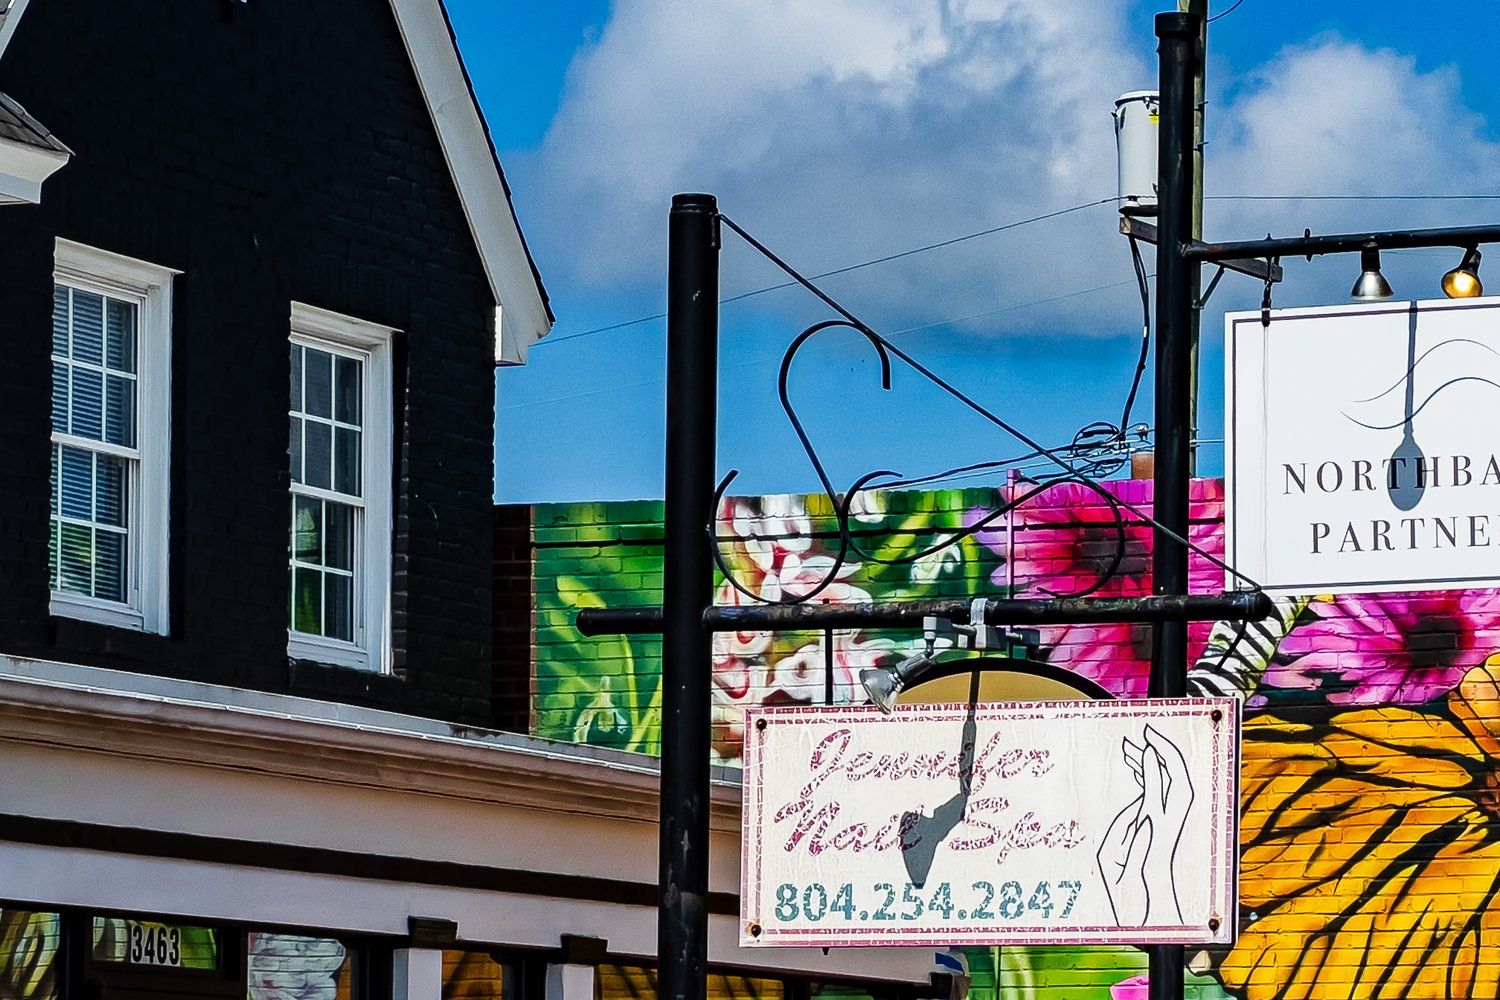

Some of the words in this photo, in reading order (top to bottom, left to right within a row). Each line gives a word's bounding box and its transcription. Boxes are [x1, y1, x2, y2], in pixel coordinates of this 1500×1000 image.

[800, 729, 1055, 801] Jennifer
[774, 802, 926, 855] Nail
[949, 797, 1086, 865] Spa
[774, 880, 1083, 921] 804.254.2847
[132, 925, 180, 965] 3463
